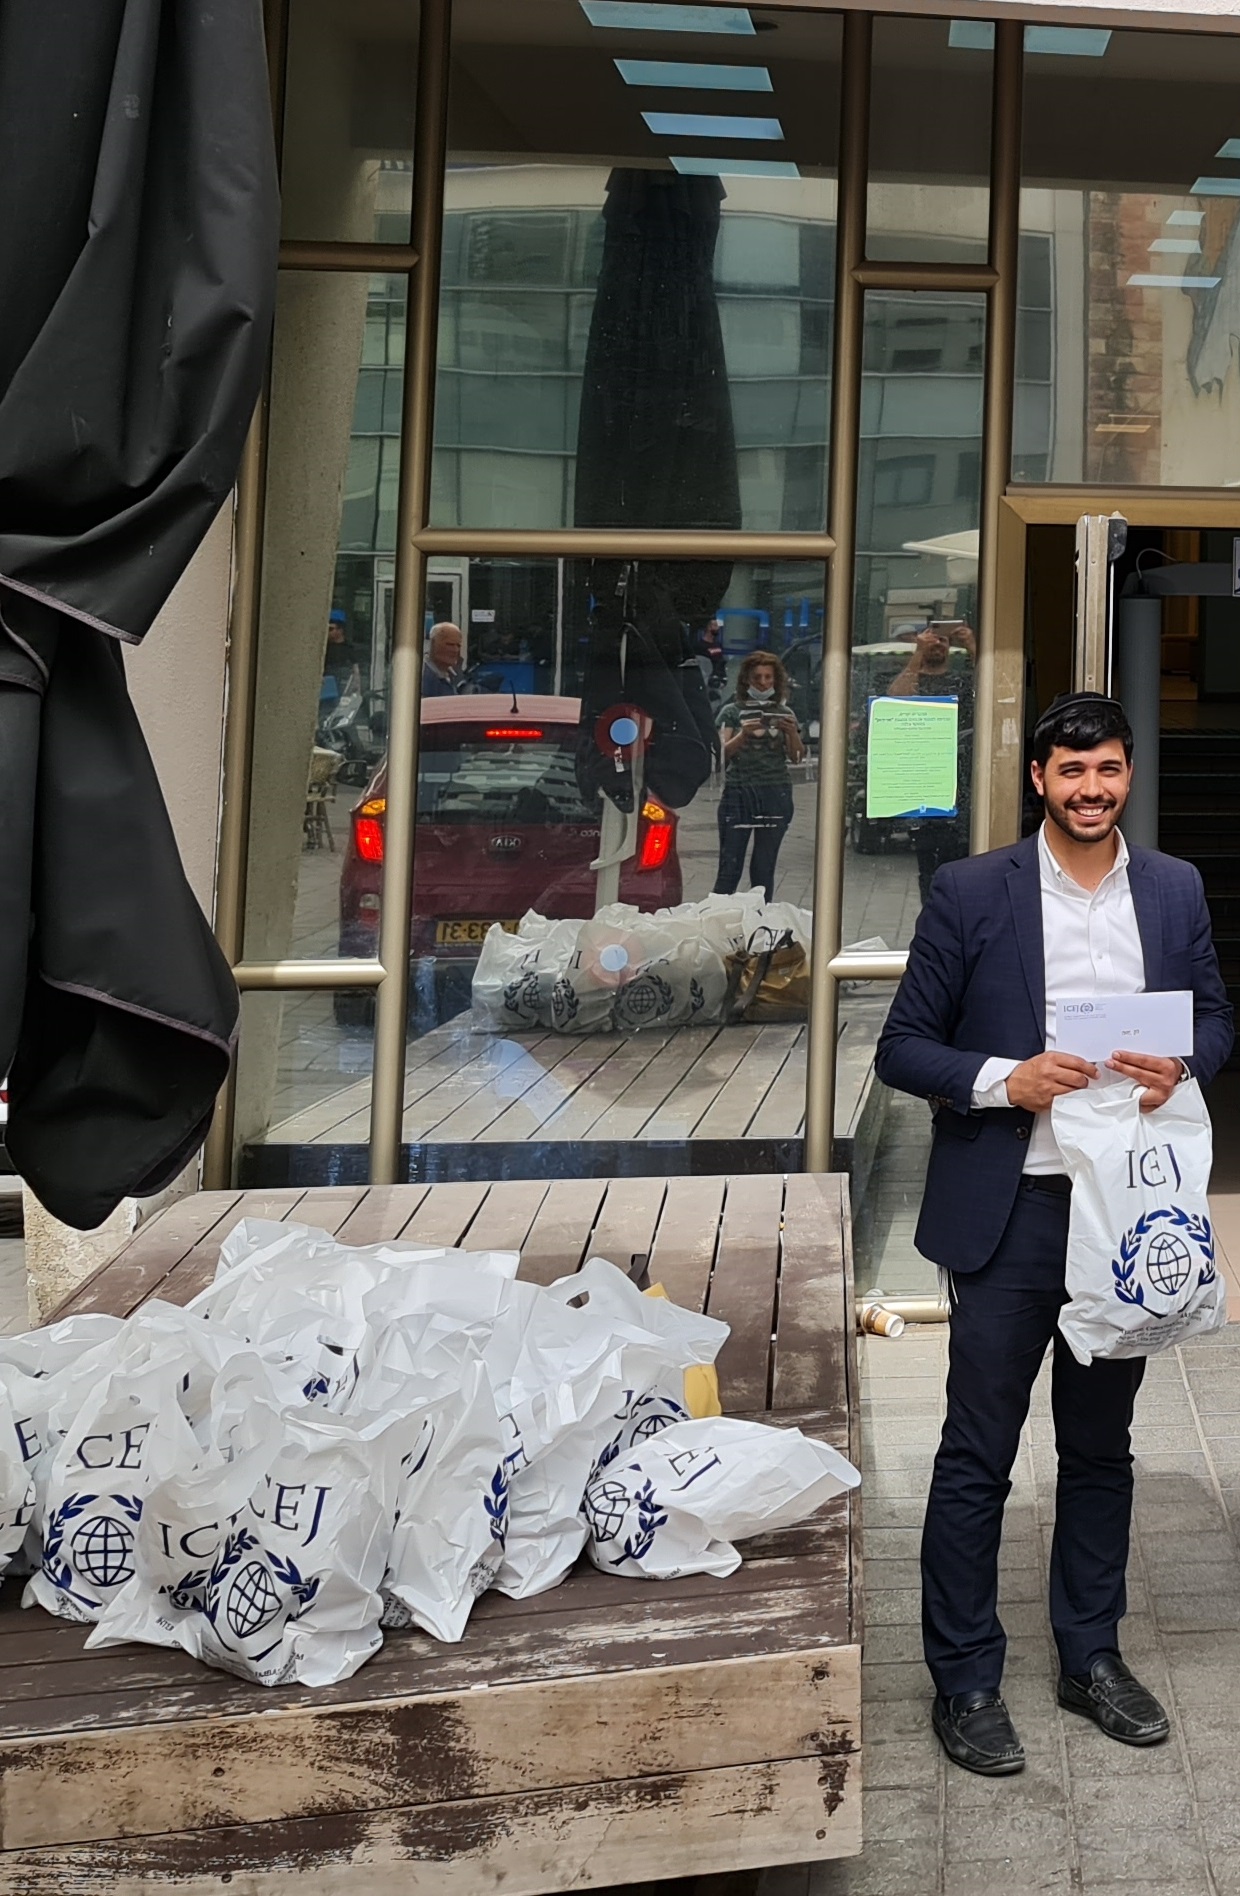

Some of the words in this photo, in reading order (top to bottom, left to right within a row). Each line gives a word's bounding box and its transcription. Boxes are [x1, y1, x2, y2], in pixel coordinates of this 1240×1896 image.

[1125, 1143, 1182, 1193] ICEJ
[66, 1422, 151, 1471] CE
[158, 1522, 219, 1560] IC
